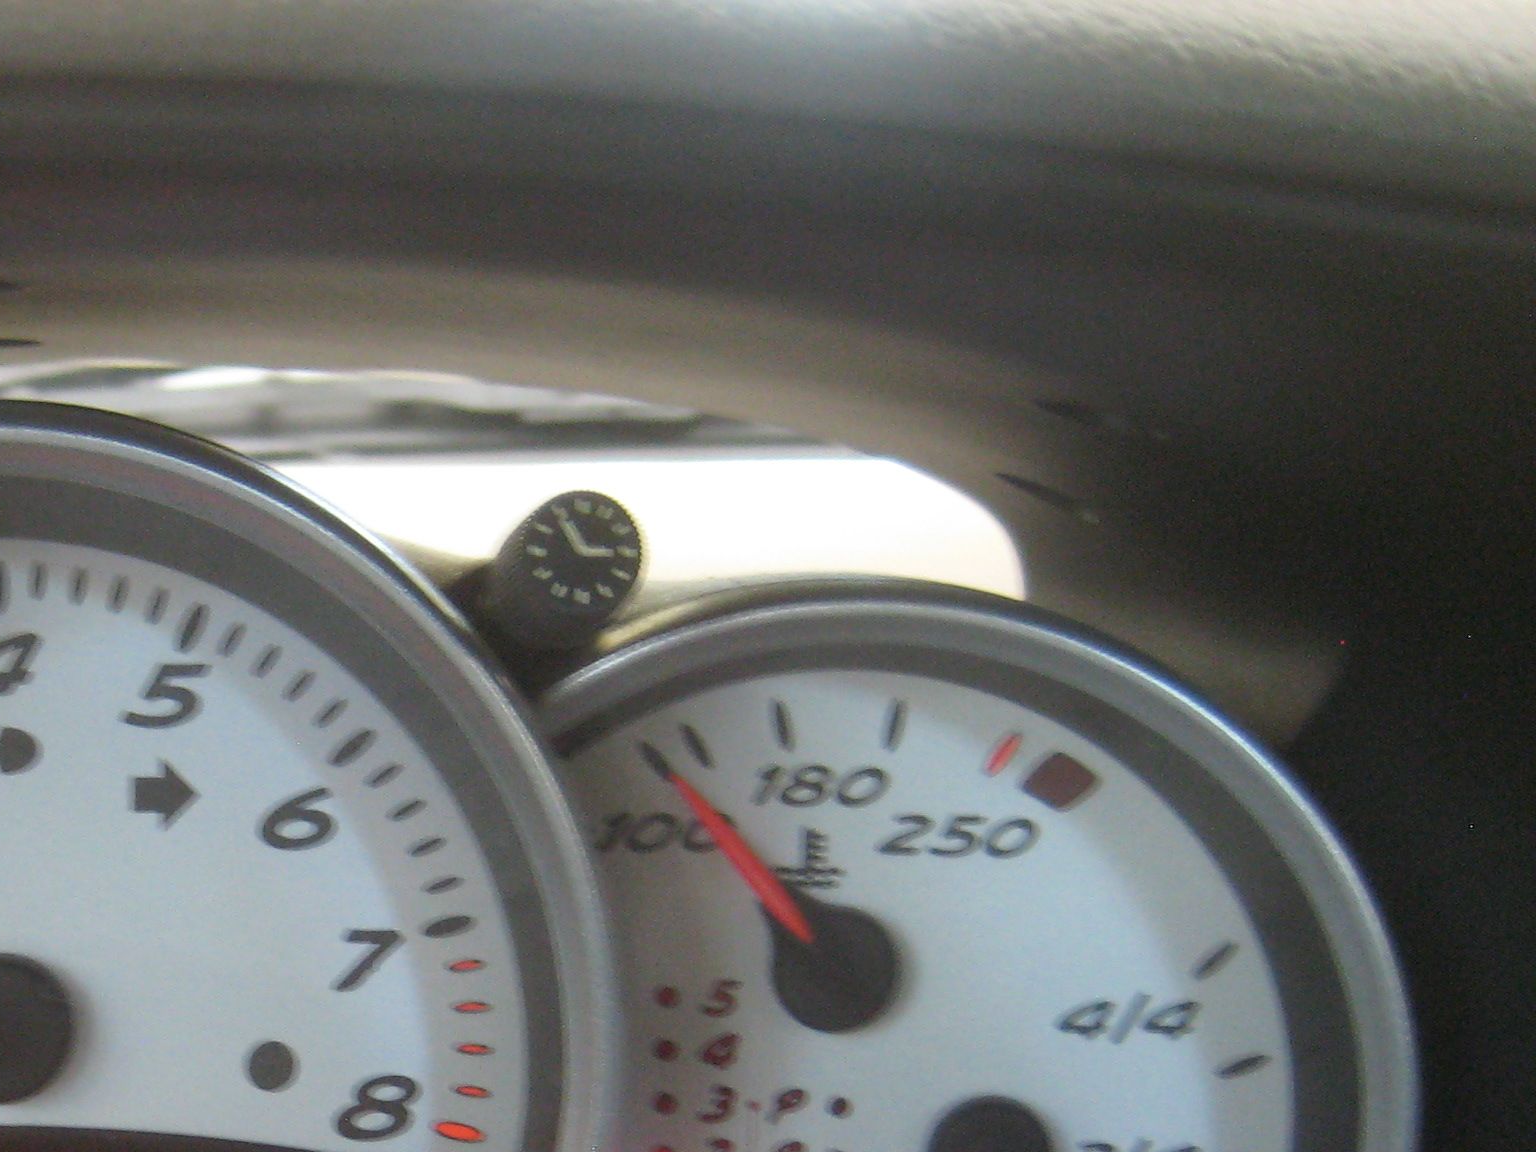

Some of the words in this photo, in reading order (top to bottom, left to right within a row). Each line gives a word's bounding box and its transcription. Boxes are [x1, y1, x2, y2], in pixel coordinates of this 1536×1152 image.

[122, 663, 212, 729] 5
[750, 763, 890, 809] 180
[259, 788, 336, 851] 6
[875, 815, 1037, 858] 250
[334, 929, 406, 992] 7
[699, 979, 745, 1017] 5
[1054, 993, 1200, 1045] 4/4
[335, 1075, 420, 1142] 8
